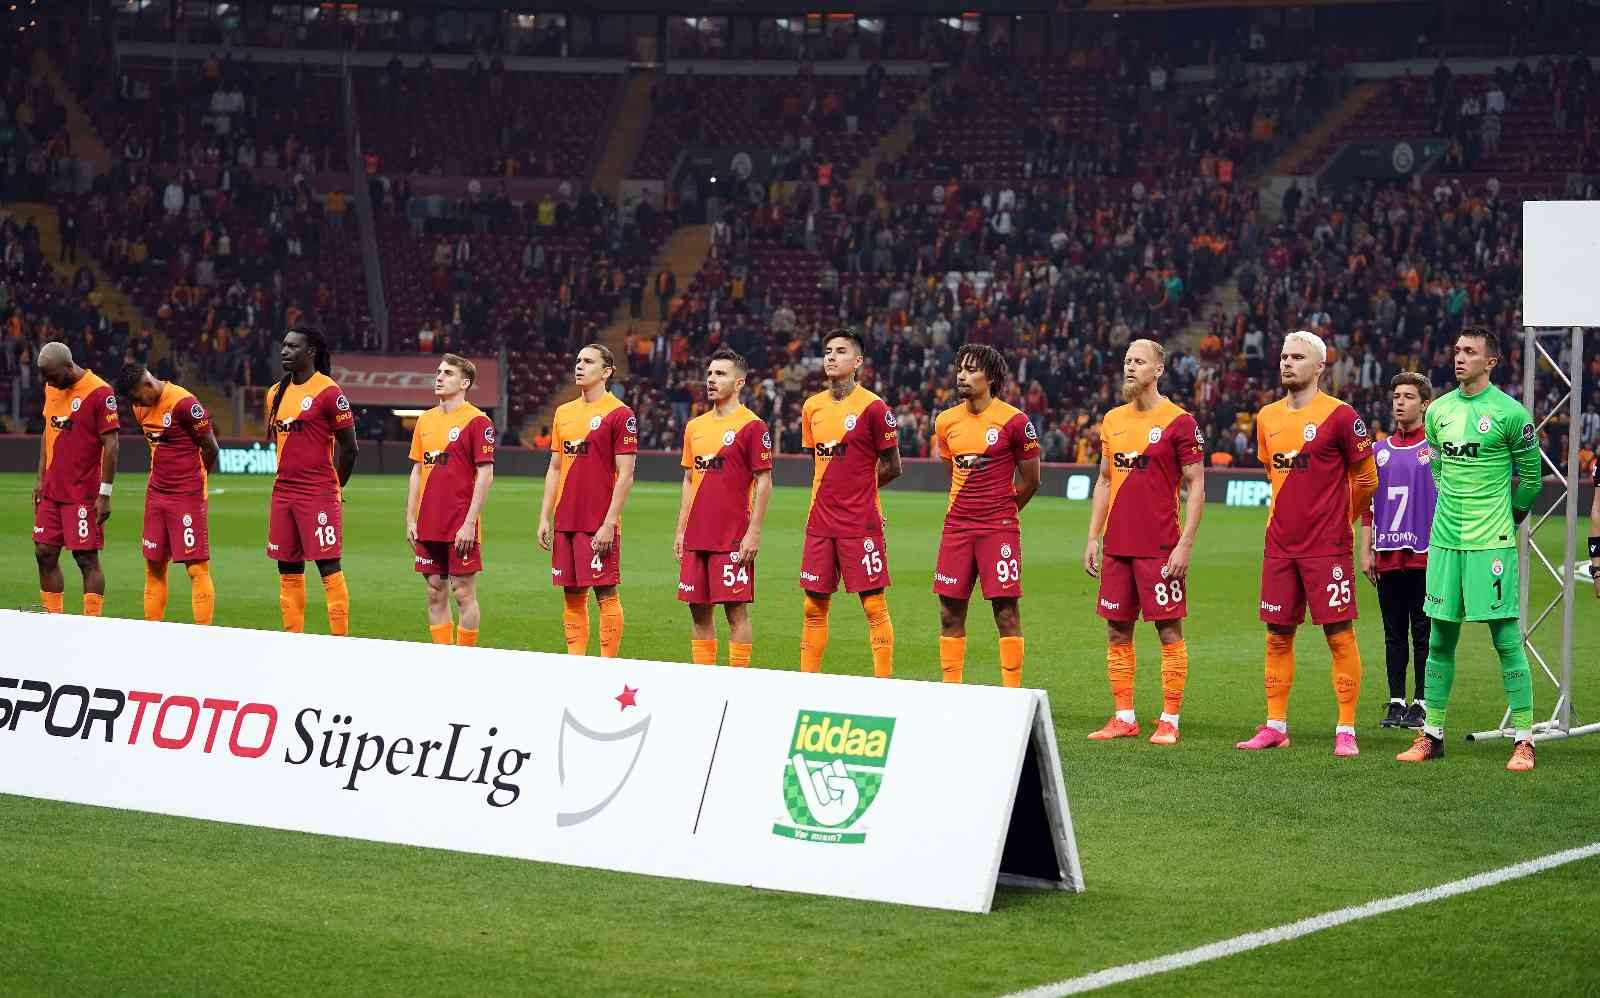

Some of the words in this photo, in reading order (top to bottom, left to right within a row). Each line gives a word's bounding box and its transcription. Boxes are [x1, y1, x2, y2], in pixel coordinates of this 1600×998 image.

[1387, 486, 1409, 531] 7
[78, 519, 89, 538] 8
[183, 527, 195, 547] 6
[315, 525, 337, 546] 18
[590, 555, 603, 571] 4
[861, 551, 883, 576] 15
[996, 559, 1019, 583] 93
[722, 564, 749, 586] 54
[1155, 579, 1183, 605] 88
[1326, 580, 1351, 607] 25
[1492, 578, 1502, 601] 1
[795, 714, 888, 758] iddaa
